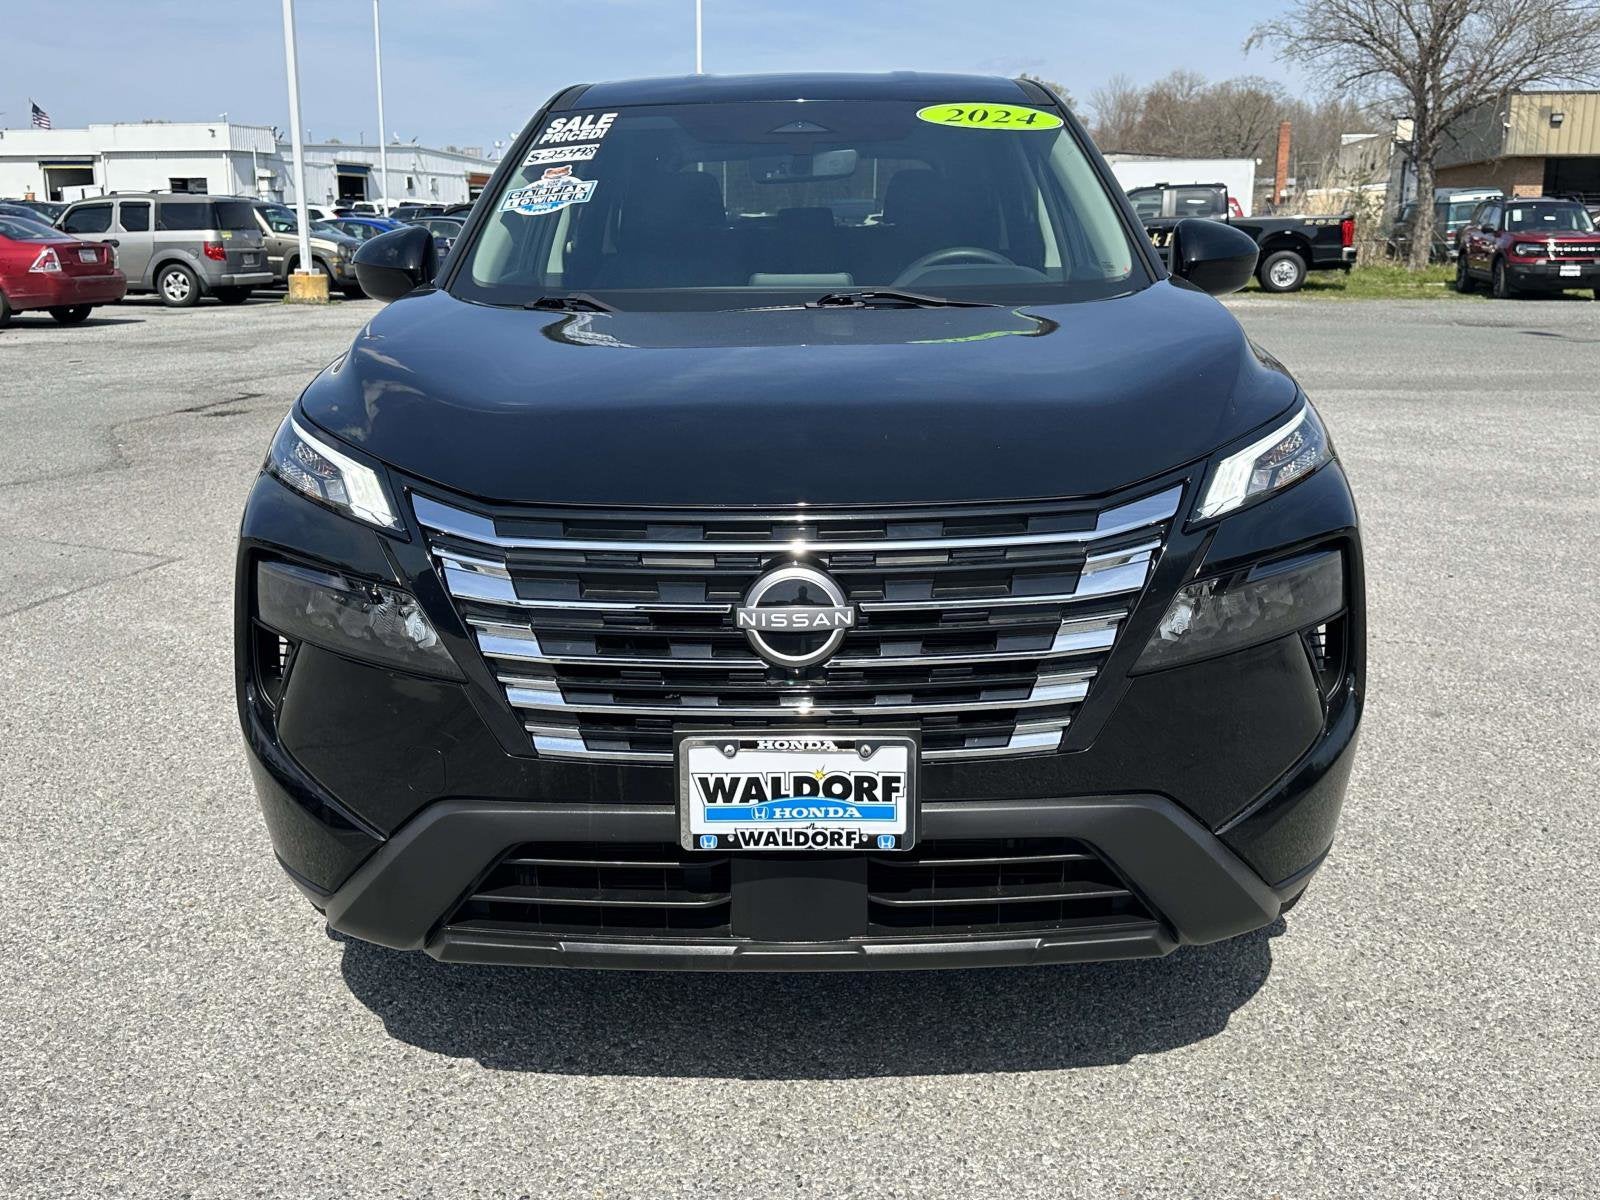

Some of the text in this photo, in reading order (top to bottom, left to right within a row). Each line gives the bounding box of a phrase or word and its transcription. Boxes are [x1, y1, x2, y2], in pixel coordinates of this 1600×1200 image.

[546, 112, 618, 134] SALE
[945, 108, 1037, 125] 2024
[538, 127, 609, 145] PRICED!
[508, 184, 588, 200] CARFAX
[519, 192, 587, 206] OWNER
[739, 610, 851, 628] NISSAN
[756, 739, 839, 751] HONDA
[697, 774, 902, 804] WALDORF
[772, 806, 863, 820] HONDA
[738, 830, 858, 848] WALDORF
